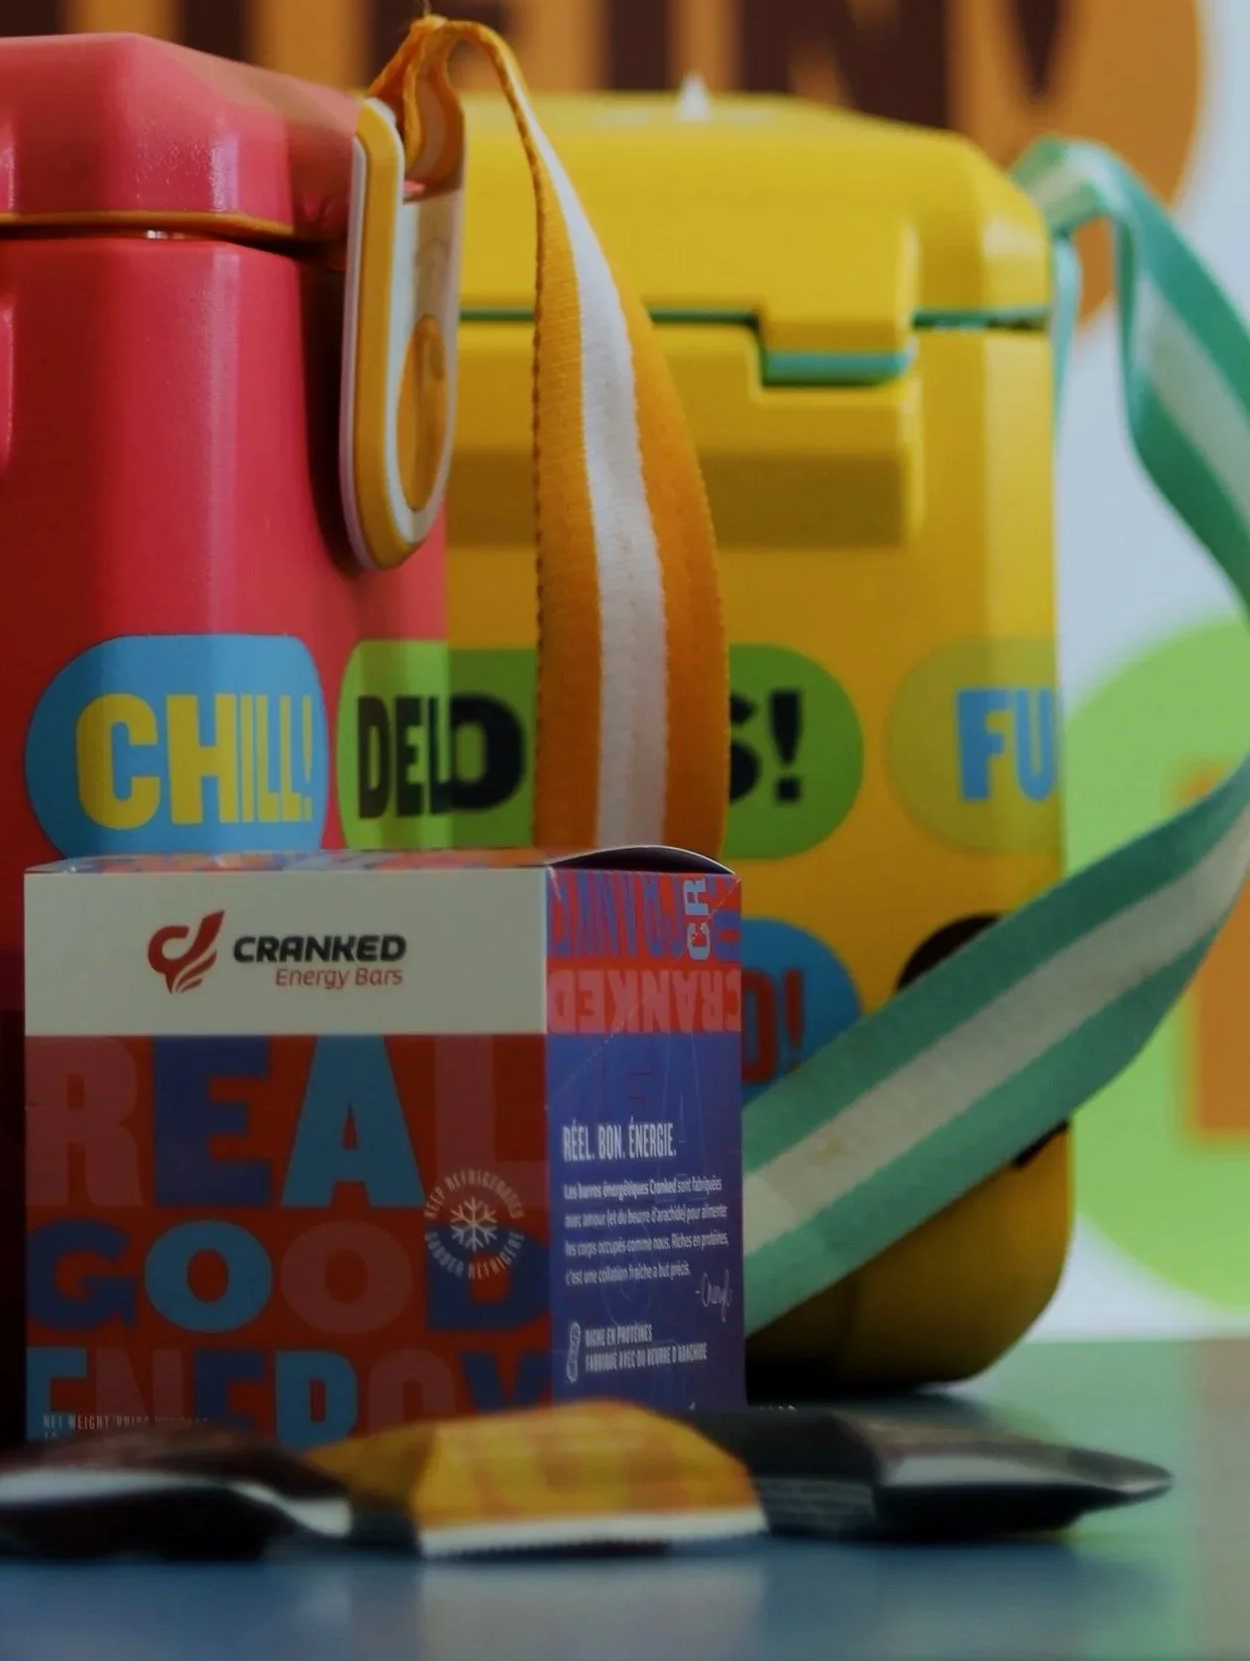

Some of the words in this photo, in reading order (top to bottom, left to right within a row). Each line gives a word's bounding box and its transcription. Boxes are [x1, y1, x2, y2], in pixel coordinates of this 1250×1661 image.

[76, 692, 314, 830] CHILL!
[234, 935, 406, 962] CRANKED
[276, 968, 350, 990] Energy
[355, 968, 402, 986] Bars
[25, 1035, 547, 1208] REAL
[598, 1124, 626, 1160] BON.
[27, 1219, 547, 1335] GOOD
